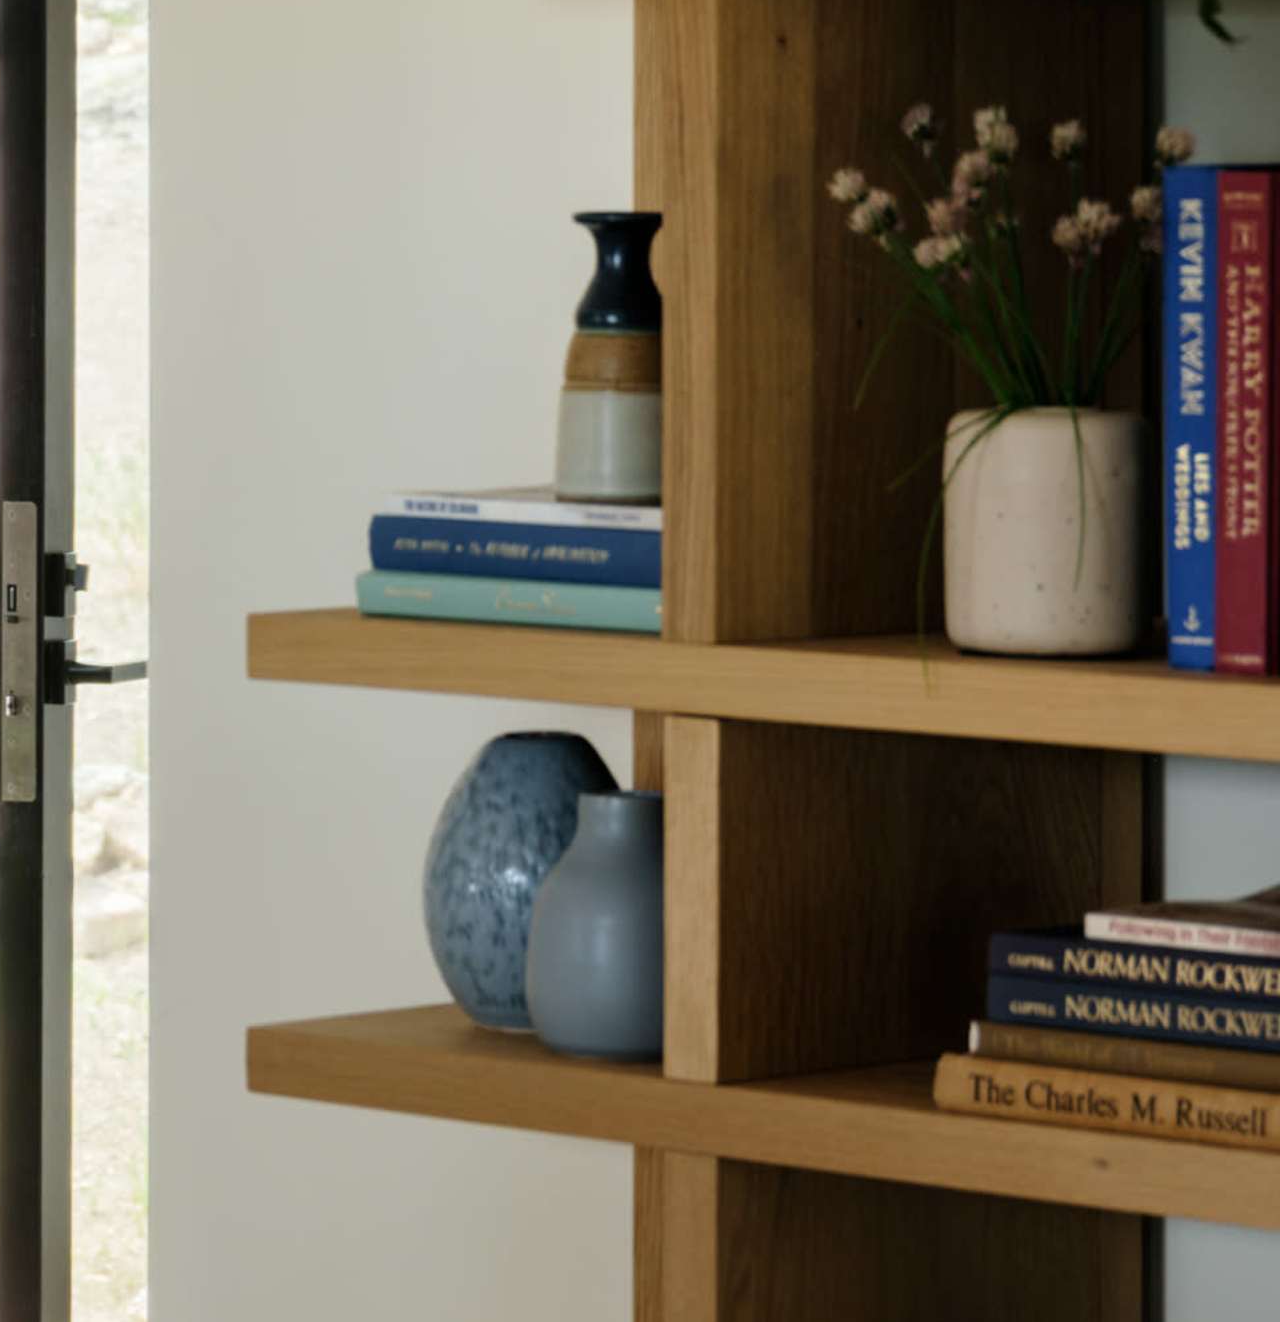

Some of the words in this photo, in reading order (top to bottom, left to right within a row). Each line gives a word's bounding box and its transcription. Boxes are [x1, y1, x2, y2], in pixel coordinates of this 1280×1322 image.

[1178, 198, 1204, 302] KEVIN
[1226, 264, 1239, 314] AND
[1242, 265, 1264, 395] HARRY
[1179, 312, 1205, 416] KWAN
[1174, 442, 1191, 550] WEDDINGS
[1193, 452, 1210, 495] LIES
[1242, 408, 1262, 537] POTTER
[1193, 497, 1211, 542] AND
[1062, 947, 1171, 984] NORMAN
[1064, 994, 1171, 1030] NORMAN
[969, 1073, 1016, 1106] The
[1024, 1078, 1120, 1119] Charles
[1131, 1094, 1168, 1125] M.
[1175, 1097, 1269, 1138] Russell
